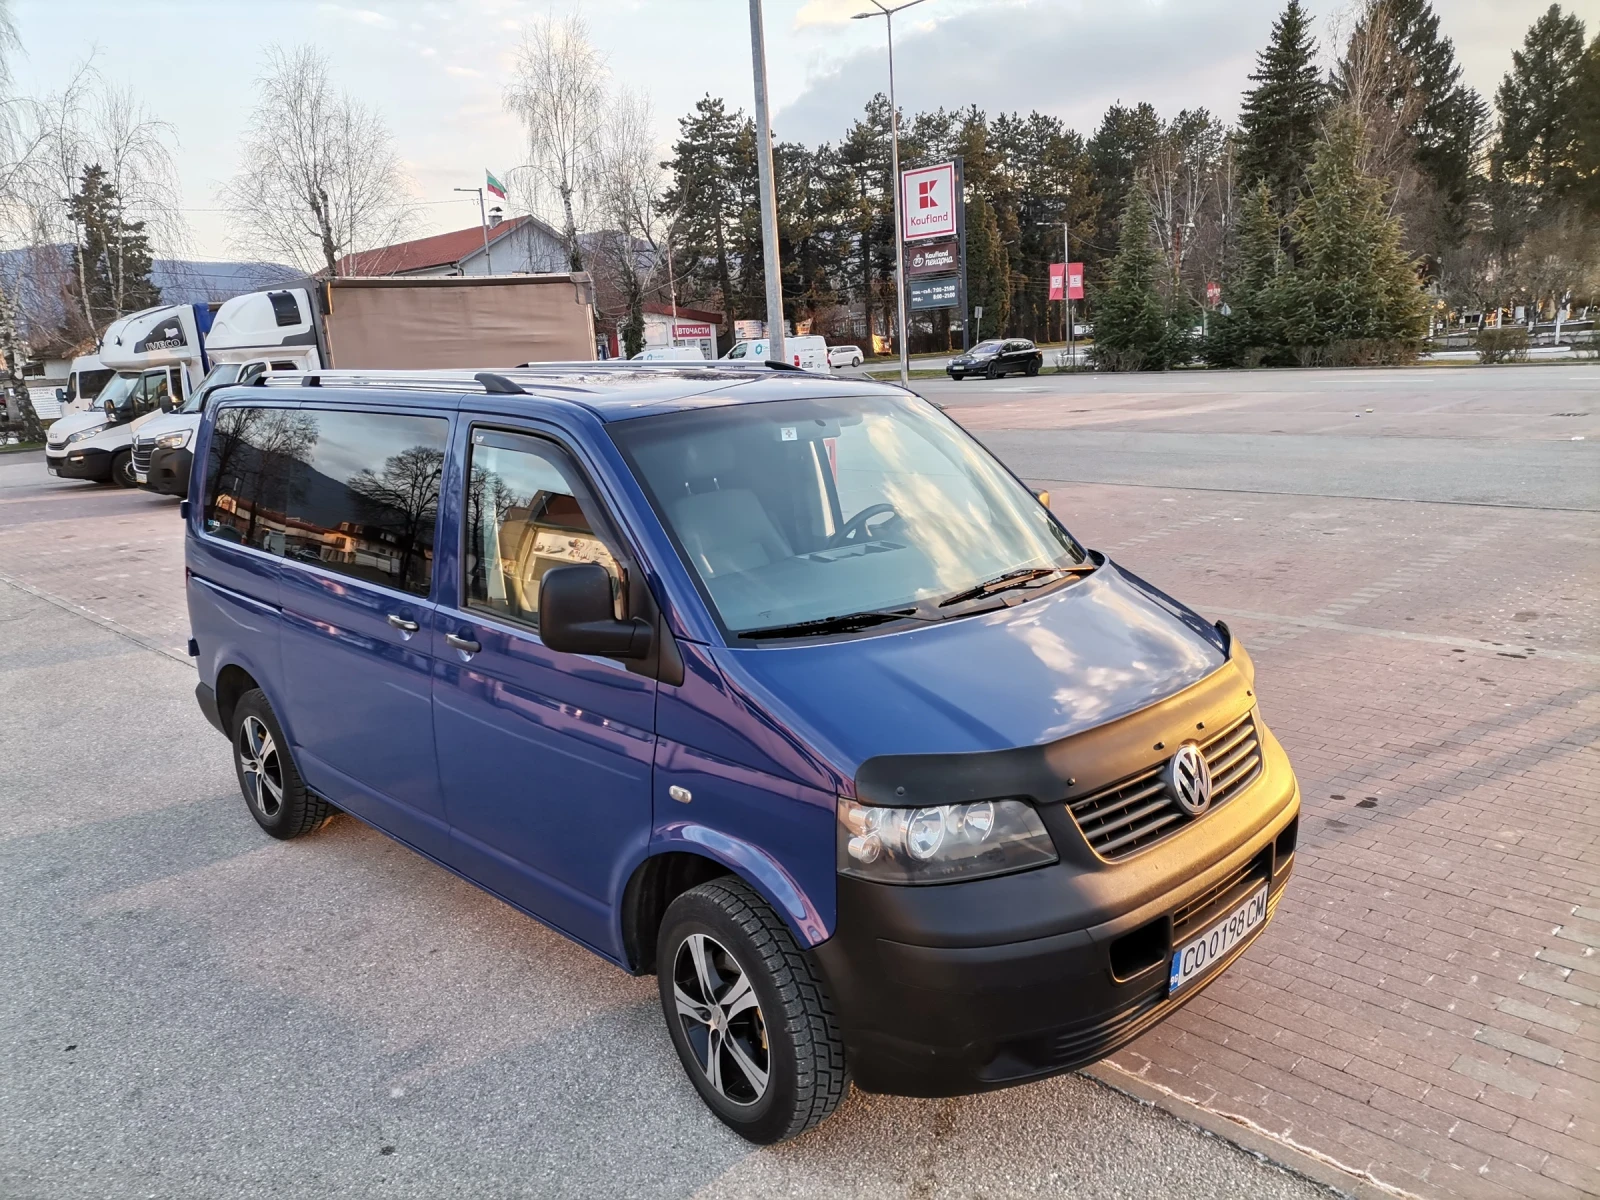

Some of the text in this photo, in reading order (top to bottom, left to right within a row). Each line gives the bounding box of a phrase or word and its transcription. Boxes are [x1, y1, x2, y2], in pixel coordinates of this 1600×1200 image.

[919, 179, 939, 209] K
[910, 212, 947, 226] Kaufland
[925, 250, 948, 258] Kaufland
[145, 338, 181, 351] IVECO
